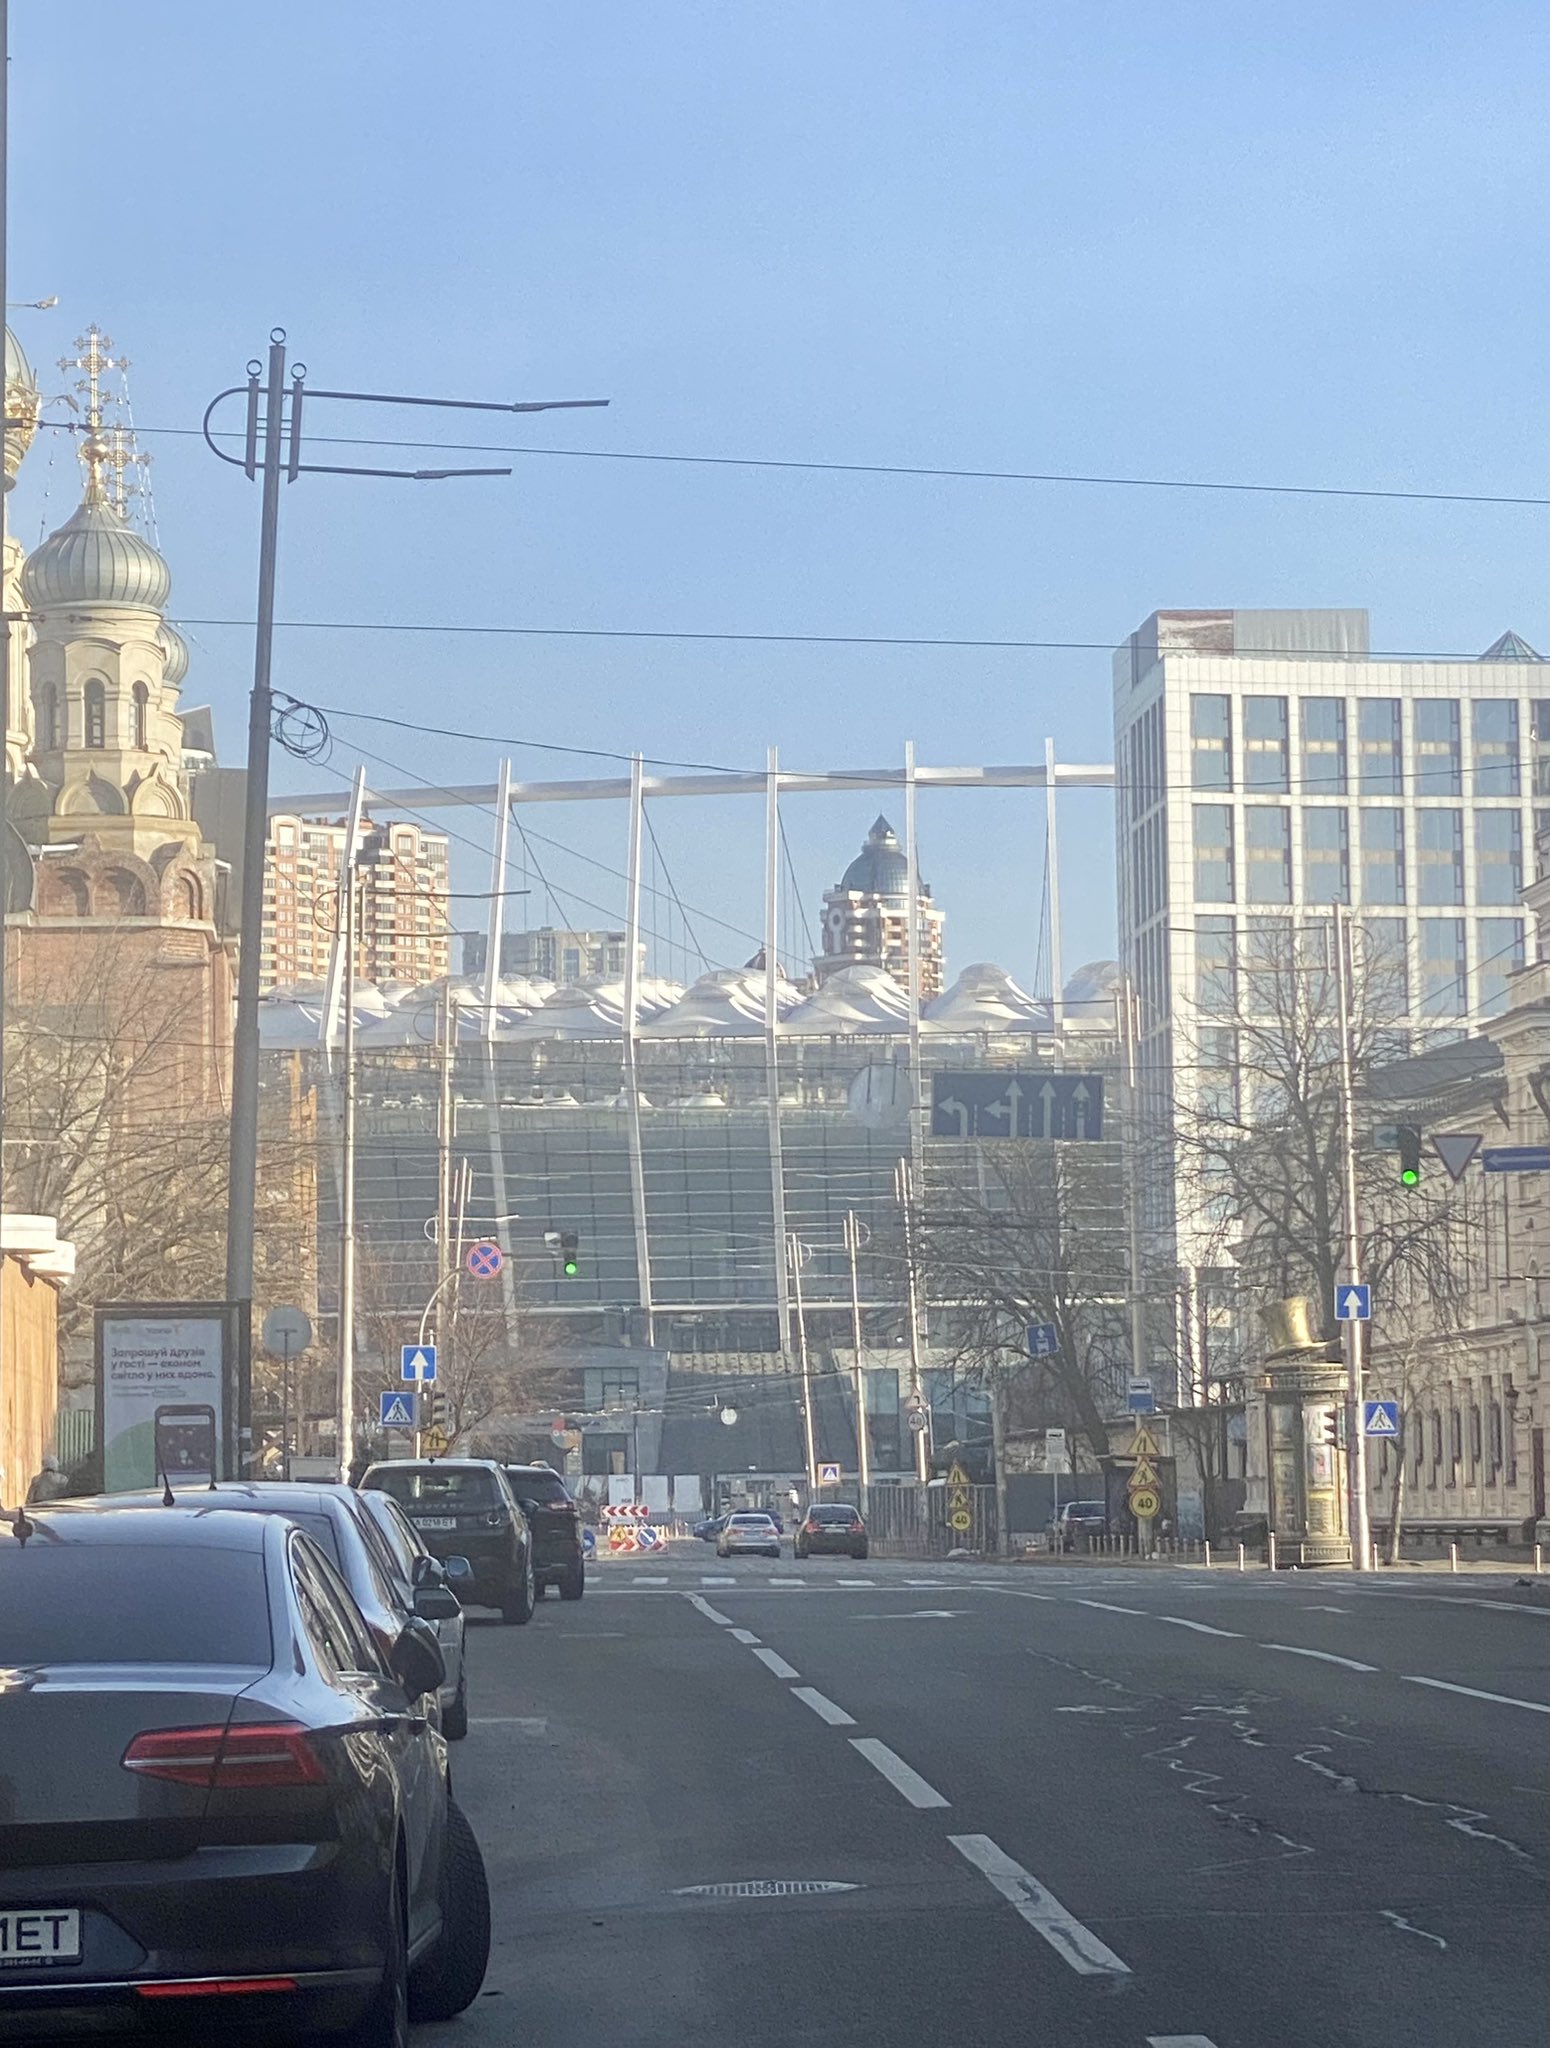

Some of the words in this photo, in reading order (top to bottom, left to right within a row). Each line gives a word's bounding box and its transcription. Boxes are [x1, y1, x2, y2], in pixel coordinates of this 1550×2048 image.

[111, 1347, 168, 1359] Запрошуй
[169, 1347, 205, 1358] друзів
[111, 1361, 118, 1369] у
[119, 1360, 145, 1368] гості
[111, 1371, 145, 1379] світло
[147, 1372, 154, 1381] у
[1137, 1498, 1153, 1508] 40
[955, 1514, 967, 1524] 40
